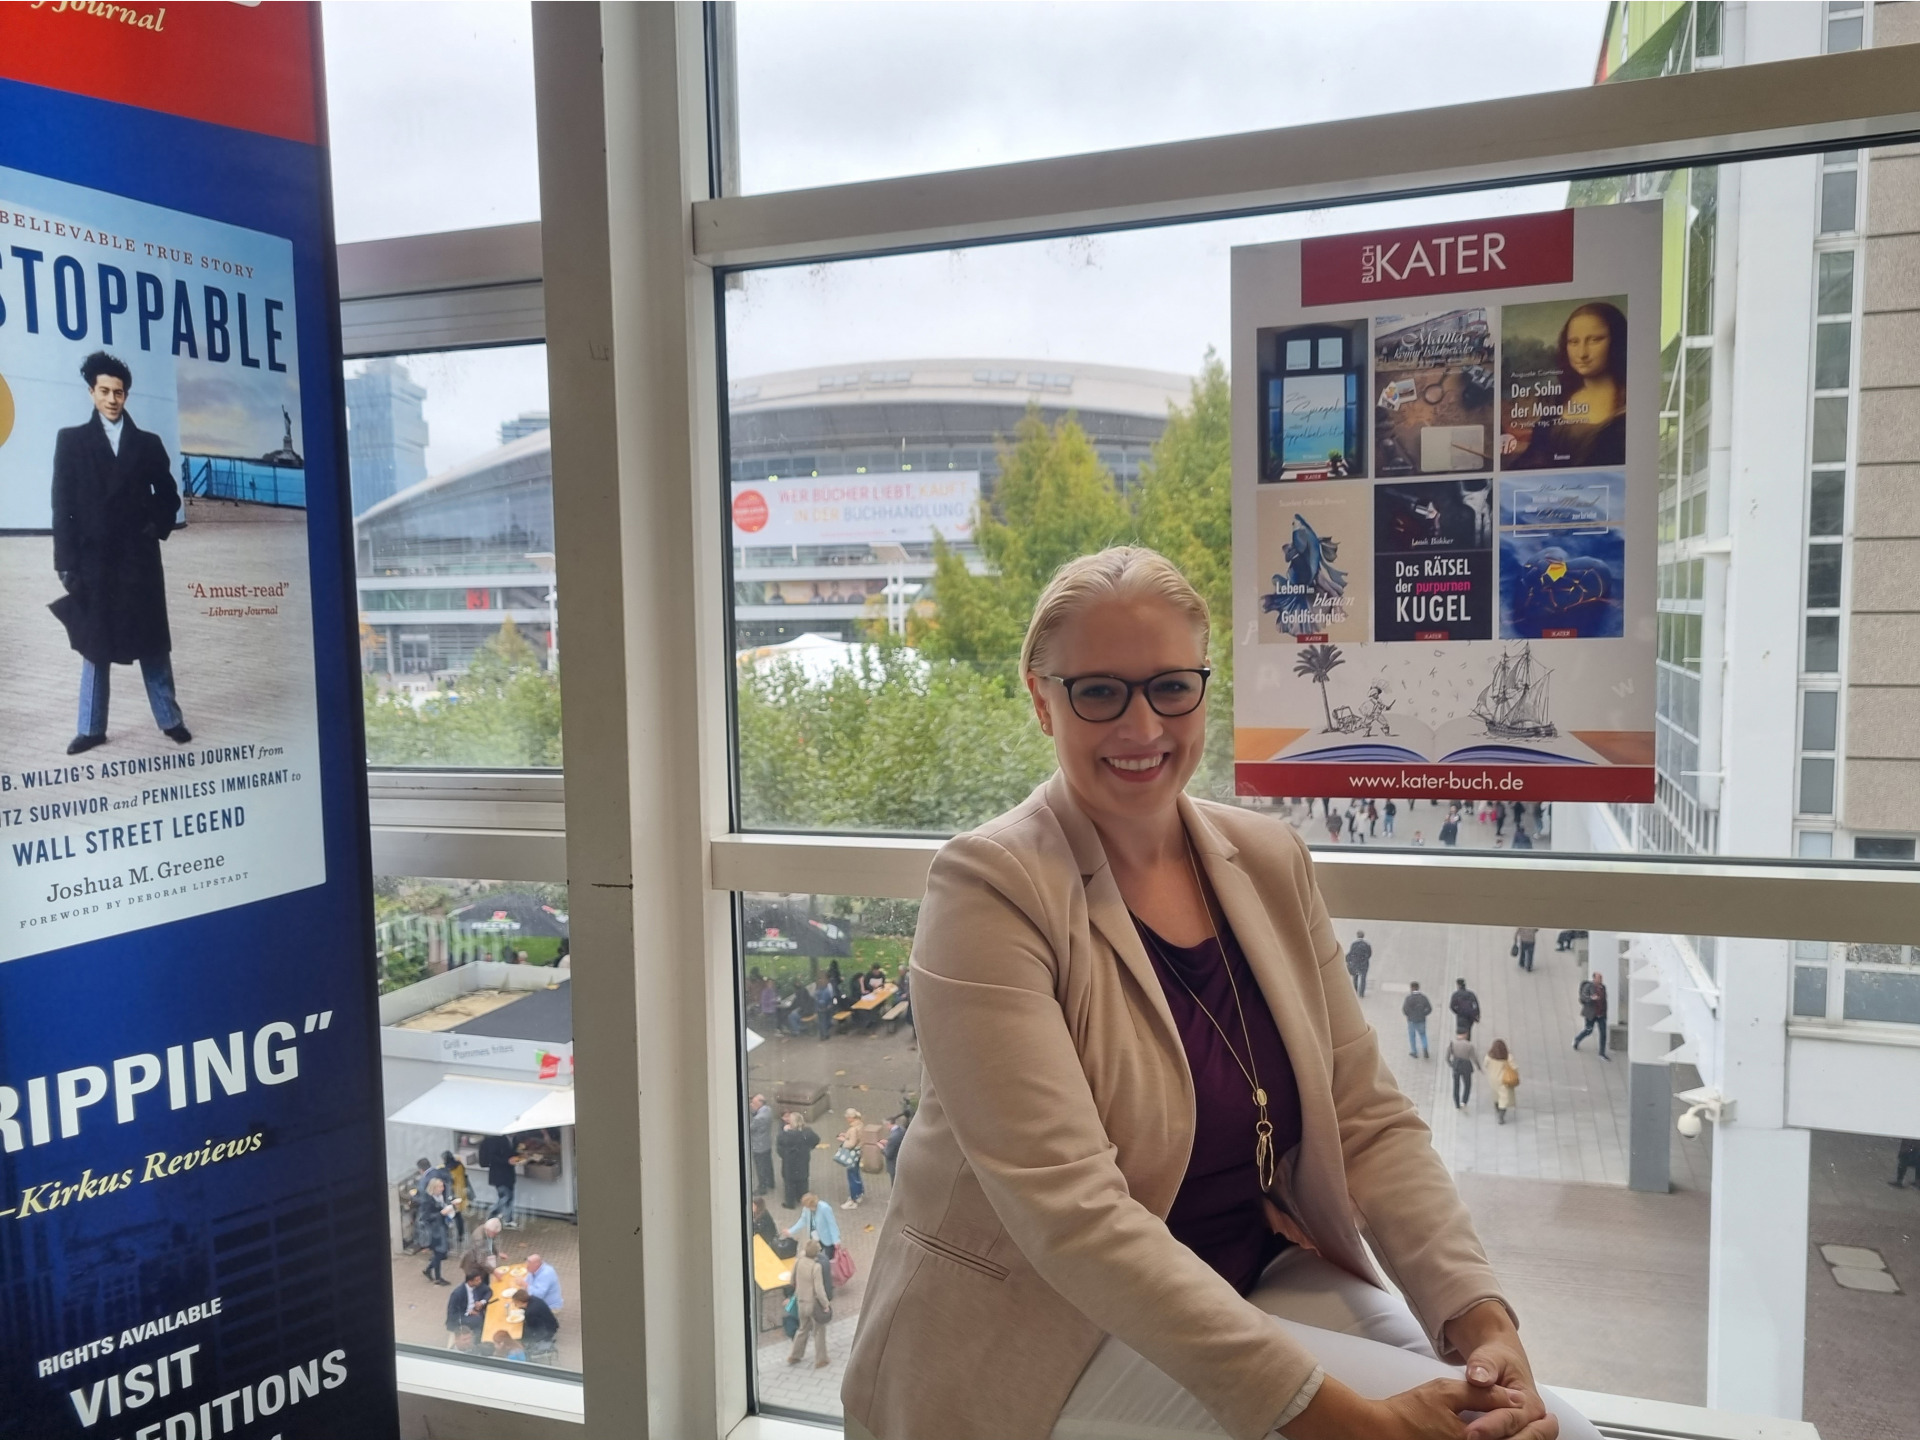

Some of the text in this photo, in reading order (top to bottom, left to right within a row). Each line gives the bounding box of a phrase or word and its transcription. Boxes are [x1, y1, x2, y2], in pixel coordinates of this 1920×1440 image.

[0, 210, 254, 279] BELIEVABLE TRUE STORY
[1361, 232, 1507, 283] BUCH KATER
[0, 245, 287, 373] TOPPABLE
[1511, 380, 1561, 398] Der Sohn
[1511, 400, 1589, 418] der Mona Lisa
[844, 503, 964, 522] BUCHHANDLUNG
[1395, 556, 1471, 577] Das RÄTSEL
[187, 582, 289, 598] “A must-read”
[1276, 580, 1305, 594] Leben
[1395, 579, 1470, 594] der purpurnen
[245, 605, 278, 616] Journal
[1313, 593, 1355, 607] blauen
[1396, 596, 1471, 622] KUGEL
[1281, 610, 1346, 625] Goldfischglas
[1, 744, 284, 792] B. WILZIG’S ASTONISHING JOURNEY from
[1349, 770, 1524, 791] www.kater-buch.de
[30, 796, 108, 822] SURVIVOR
[113, 796, 138, 810] and
[142, 781, 216, 805] PENNILESS
[221, 769, 288, 793] IMMIGRANT
[291, 772, 301, 782] to
[12, 806, 246, 867] WALL STREET LEGEND
[46, 854, 225, 903] Joshua M. Greene
[20, 872, 249, 929] FOREWORD BY DEBORAH LIPSTADT
[140, 1132, 262, 1183] Reviews
[38, 1297, 222, 1378] RIGHTS AVAILABLE
[69, 1344, 200, 1428] VISIT
